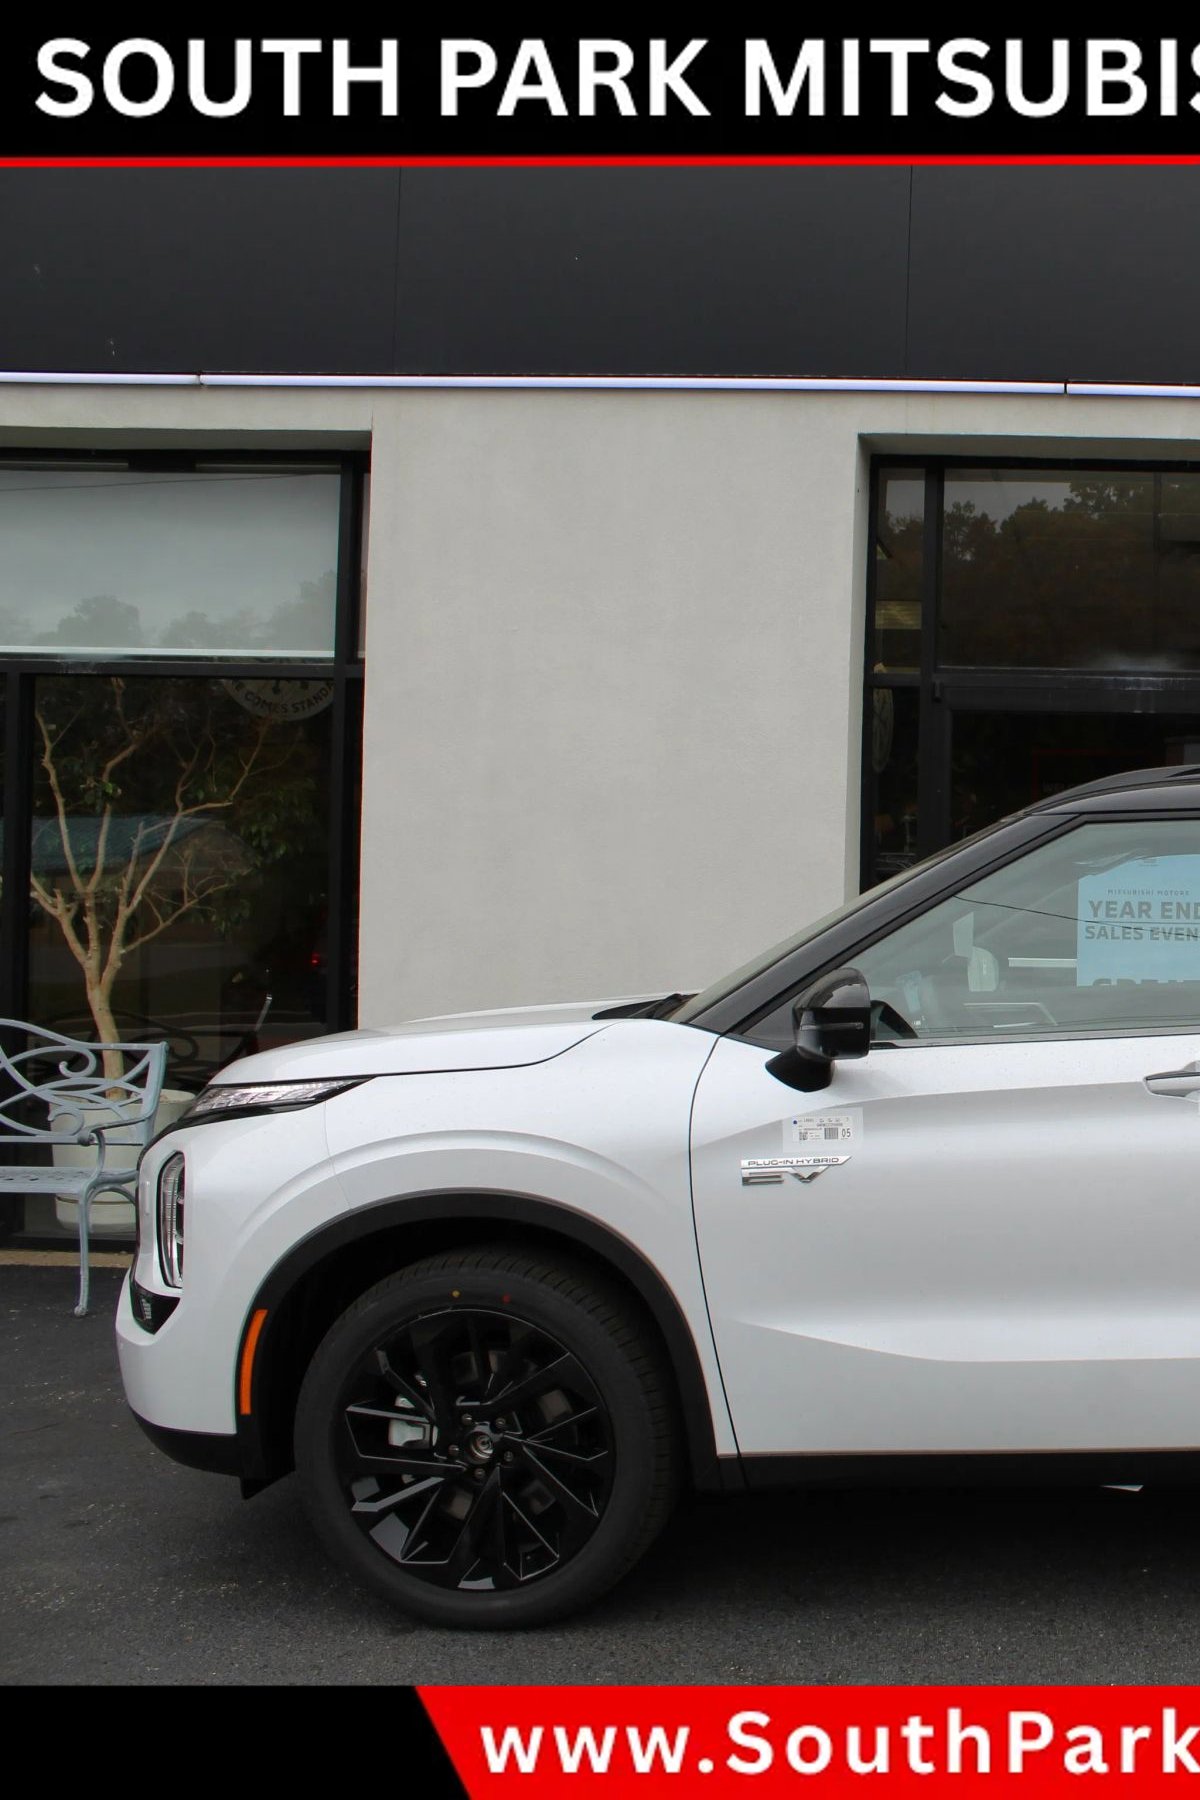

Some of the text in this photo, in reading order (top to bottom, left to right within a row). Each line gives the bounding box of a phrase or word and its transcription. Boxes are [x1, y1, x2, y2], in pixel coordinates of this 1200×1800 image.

[1088, 900, 1152, 919] YEAR
[1084, 925, 1144, 941] SALES
[796, 1157, 839, 1165] HYBRID
[741, 1166, 831, 1186] EV
